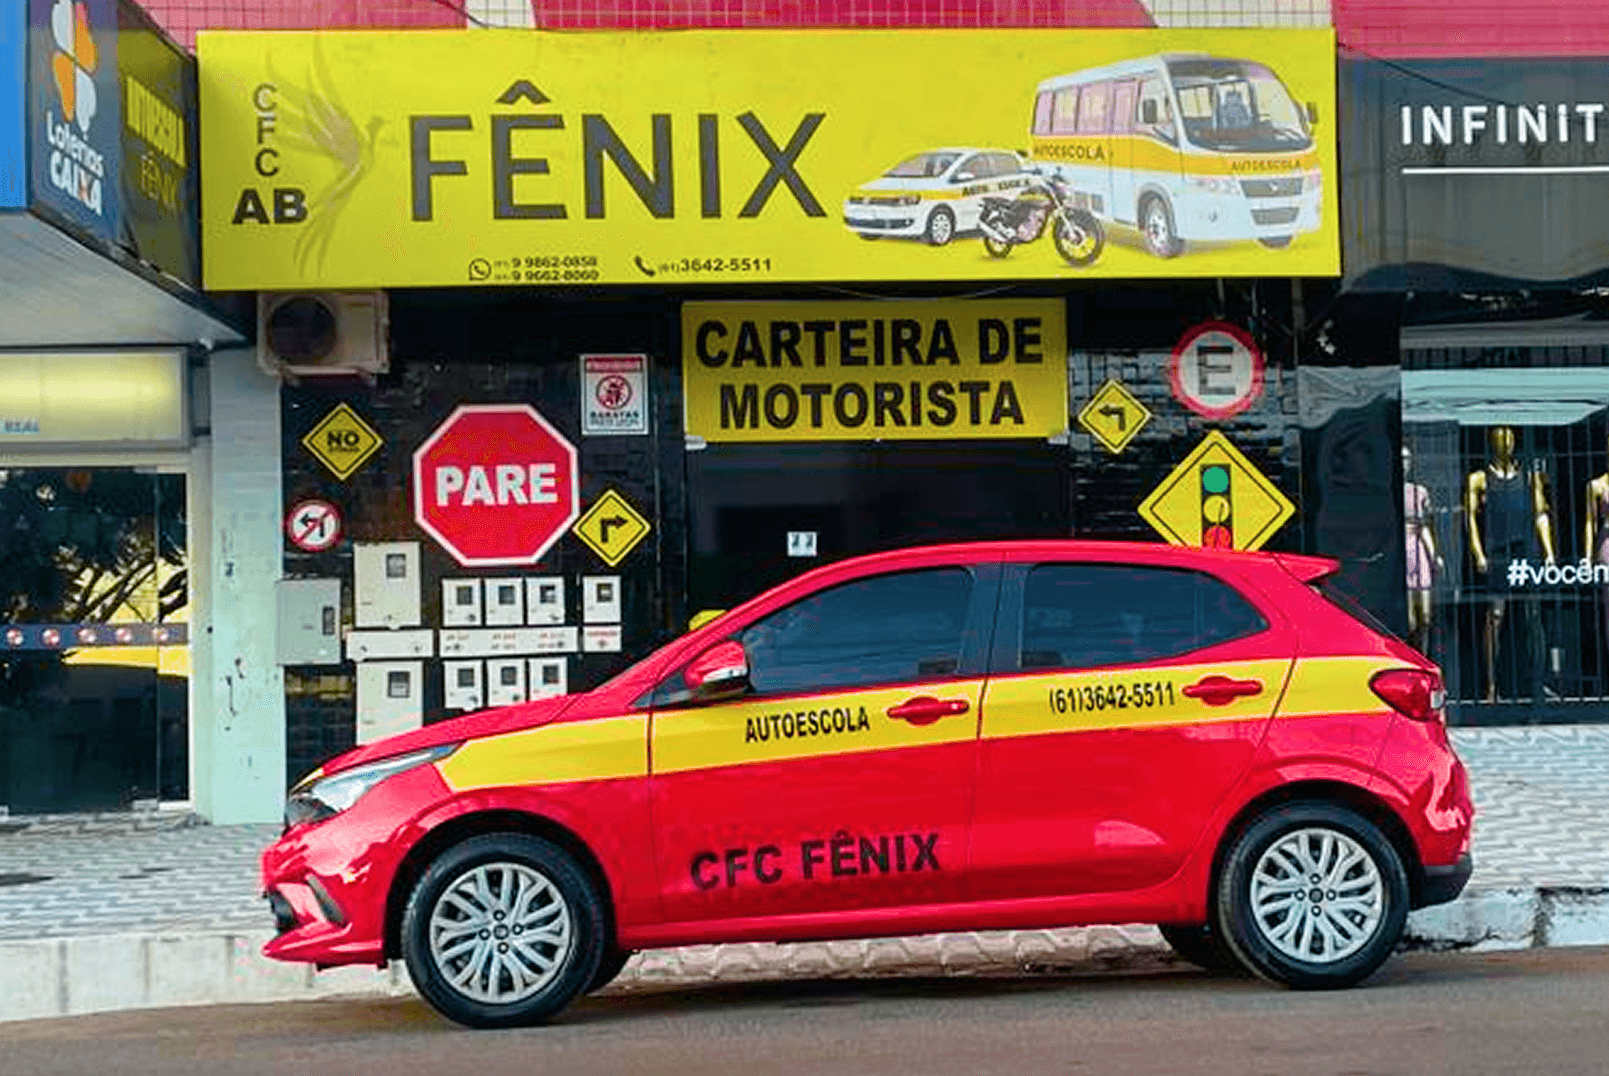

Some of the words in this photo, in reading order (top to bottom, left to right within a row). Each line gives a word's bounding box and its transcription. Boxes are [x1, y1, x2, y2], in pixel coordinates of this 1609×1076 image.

[1401, 104, 1604, 145] INFINIT
[409, 79, 829, 222] FÊNIX
[1033, 144, 1106, 160] AUTOESCOLA
[51, 150, 103, 216] CAIXA
[231, 188, 309, 225] AB
[695, 317, 961, 368] CARTEIRA
[978, 317, 1043, 366] DE
[1196, 345, 1235, 395] E
[719, 380, 1025, 429] MOTORISTA
[327, 431, 360, 446] NO
[435, 463, 558, 507] PARE
[1049, 681, 1175, 715] (61)3642-5511
[745, 706, 870, 743] AUTOESCOLA
[690, 844, 783, 892] CFC
[801, 829, 940, 880] FÊNIX
